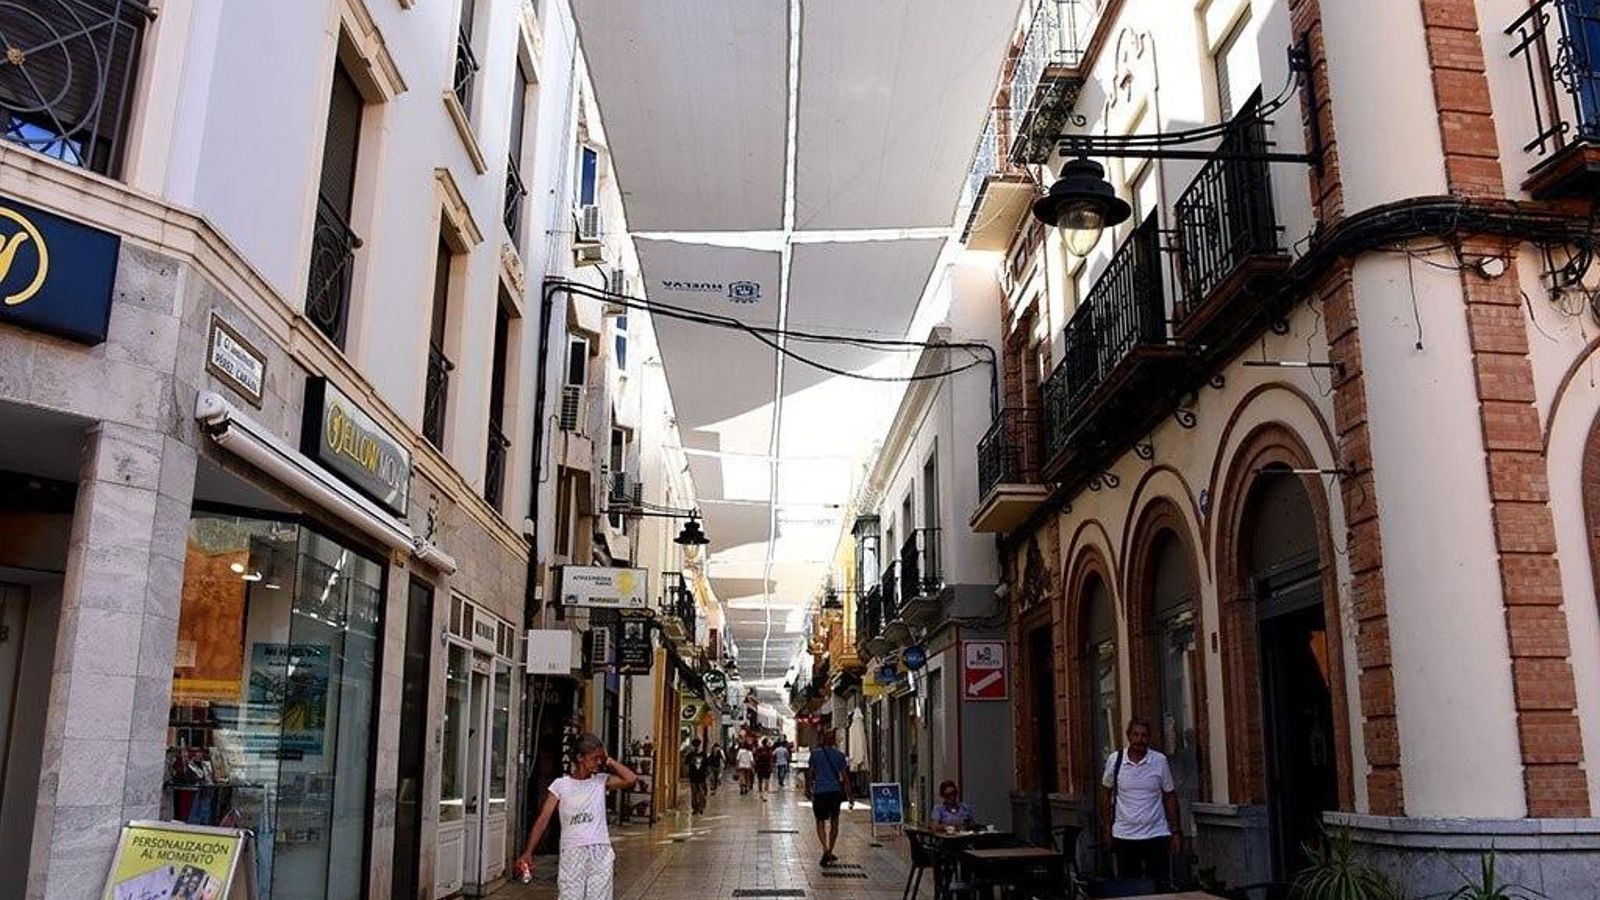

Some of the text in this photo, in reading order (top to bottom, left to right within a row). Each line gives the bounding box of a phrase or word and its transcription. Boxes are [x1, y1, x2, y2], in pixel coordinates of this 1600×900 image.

[662, 281, 722, 289] HUELVA
[131, 835, 229, 855] PERSONALIZACIÓN
[141, 848, 214, 865] AL MOMENTO
